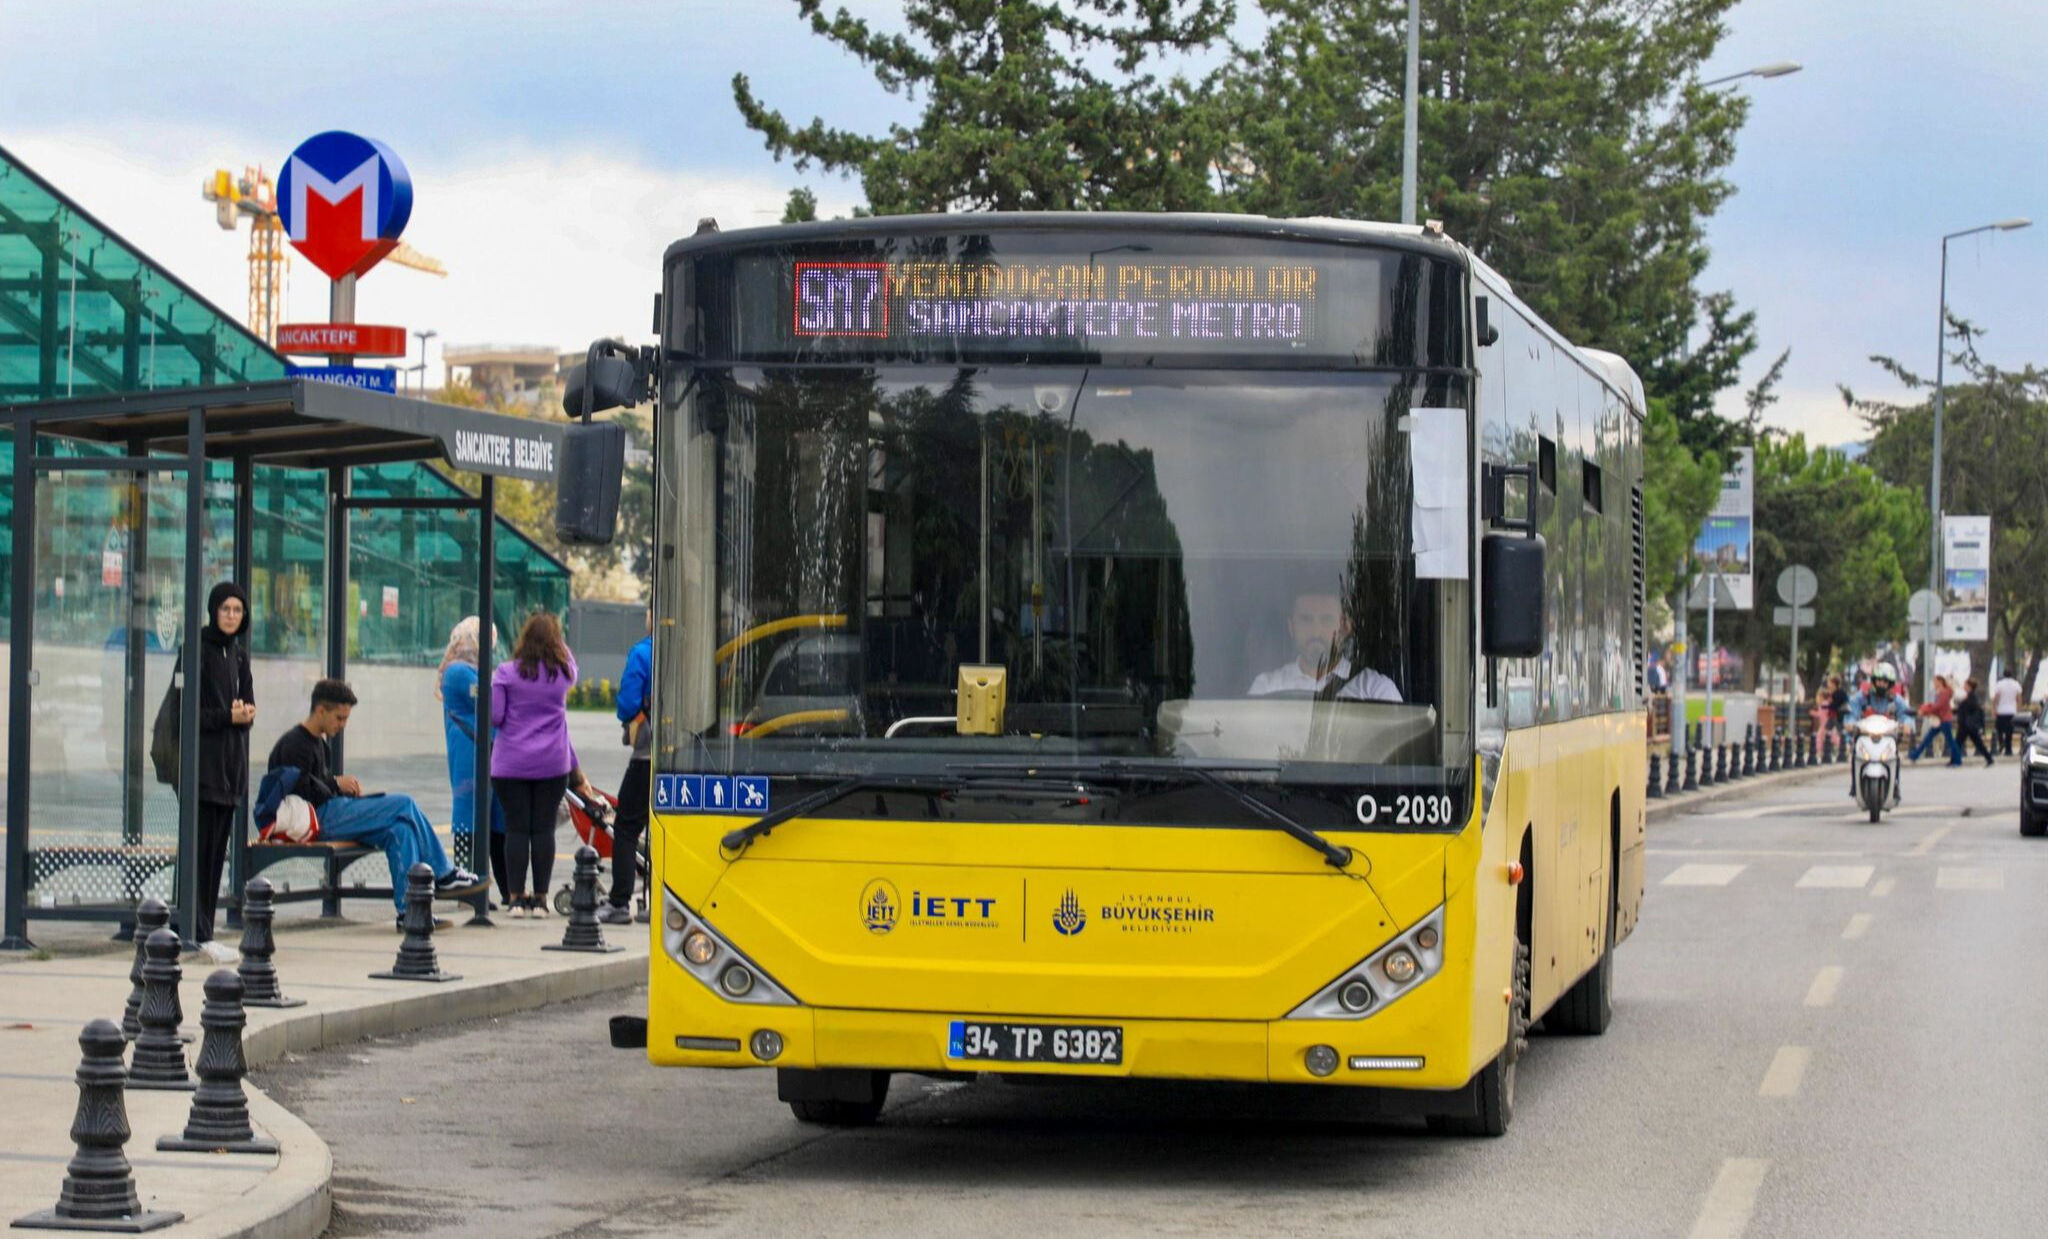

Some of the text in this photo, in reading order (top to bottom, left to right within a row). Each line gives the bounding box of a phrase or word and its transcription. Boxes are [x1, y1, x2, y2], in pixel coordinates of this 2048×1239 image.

[290, 152, 380, 242] M
[802, 269, 878, 329] SM7
[1118, 265, 1317, 299] PERONLAR
[908, 300, 1300, 337] SANCAKTEPE METRO
[455, 429, 553, 472] SANCAKTEPE BELEDİYE
[1357, 794, 1452, 824] O-2030
[912, 890, 996, 918] İETT
[1101, 903, 1215, 924] BÜYÜKŞEHİR
[1121, 894, 1192, 904] İSTANBUL
[1121, 925, 1192, 934] BELEDİYESİ
[966, 1025, 1117, 1060] 34 TP 6382
